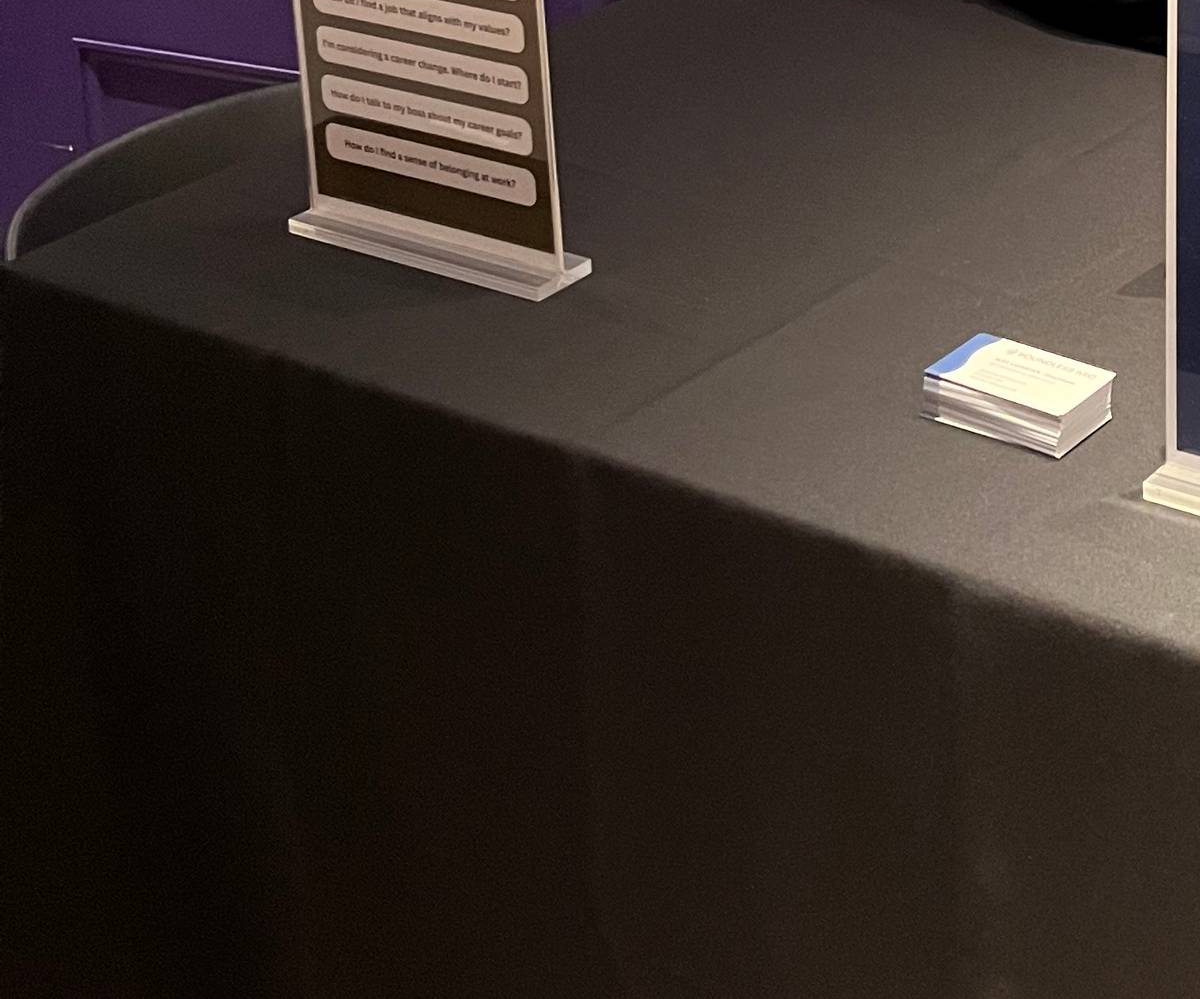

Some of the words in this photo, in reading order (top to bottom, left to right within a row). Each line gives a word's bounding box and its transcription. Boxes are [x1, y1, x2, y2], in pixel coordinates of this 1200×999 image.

[384, 4, 398, 15] job
[400, 6, 416, 17] that
[418, 11, 443, 23] aligns
[444, 17, 462, 26] with
[464, 21, 476, 32] my
[479, 24, 510, 36] values?
[336, 44, 383, 62] considering
[390, 55, 417, 66] career
[451, 66, 478, 80] Where
[479, 73, 491, 83] do
[330, 89, 348, 100] How
[350, 94, 360, 102] do
[366, 97, 380, 107] talk
[382, 101, 391, 109] to
[393, 104, 405, 115] my
[407, 106, 426, 117] boss
[427, 112, 451, 123] about
[453, 118, 466, 128] my
[467, 121, 494, 133] career
[344, 139, 362, 150] How
[364, 143, 375, 153] do
[380, 148, 396, 159] find
[404, 155, 427, 166] sense
[429, 160, 437, 169] of
[439, 162, 480, 182] belonging
[481, 174, 489, 183] at
[491, 176, 516, 188] work?
